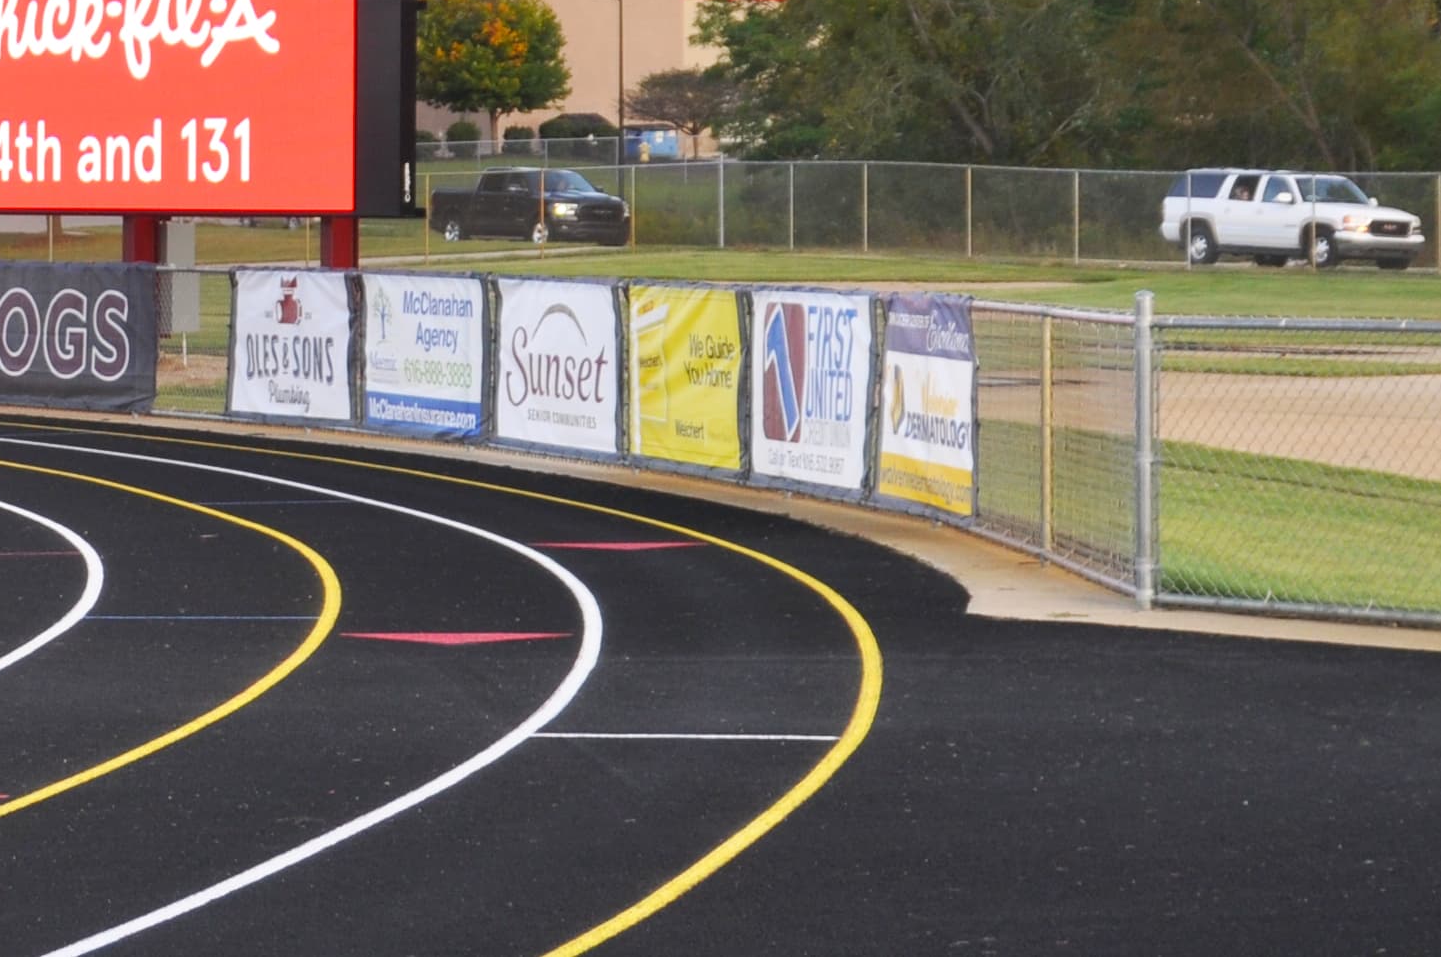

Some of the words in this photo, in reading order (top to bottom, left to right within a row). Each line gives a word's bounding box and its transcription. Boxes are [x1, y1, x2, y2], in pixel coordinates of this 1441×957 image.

[76, 118, 162, 183] and
[181, 117, 250, 183] 131
[402, 291, 473, 318] McClanahan
[416, 322, 459, 354] Agency
[689, 334, 704, 358] We
[705, 335, 735, 361] Guide
[807, 305, 858, 370] FIRST
[292, 335, 334, 386] SONS
[506, 326, 608, 407] Sunset
[684, 361, 704, 384] You
[705, 363, 732, 389] Home
[268, 379, 311, 412] Plumbing
[806, 368, 853, 422] UNITED
[527, 408, 551, 423] SENIOR
[552, 411, 597, 429] COMMUNITIES
